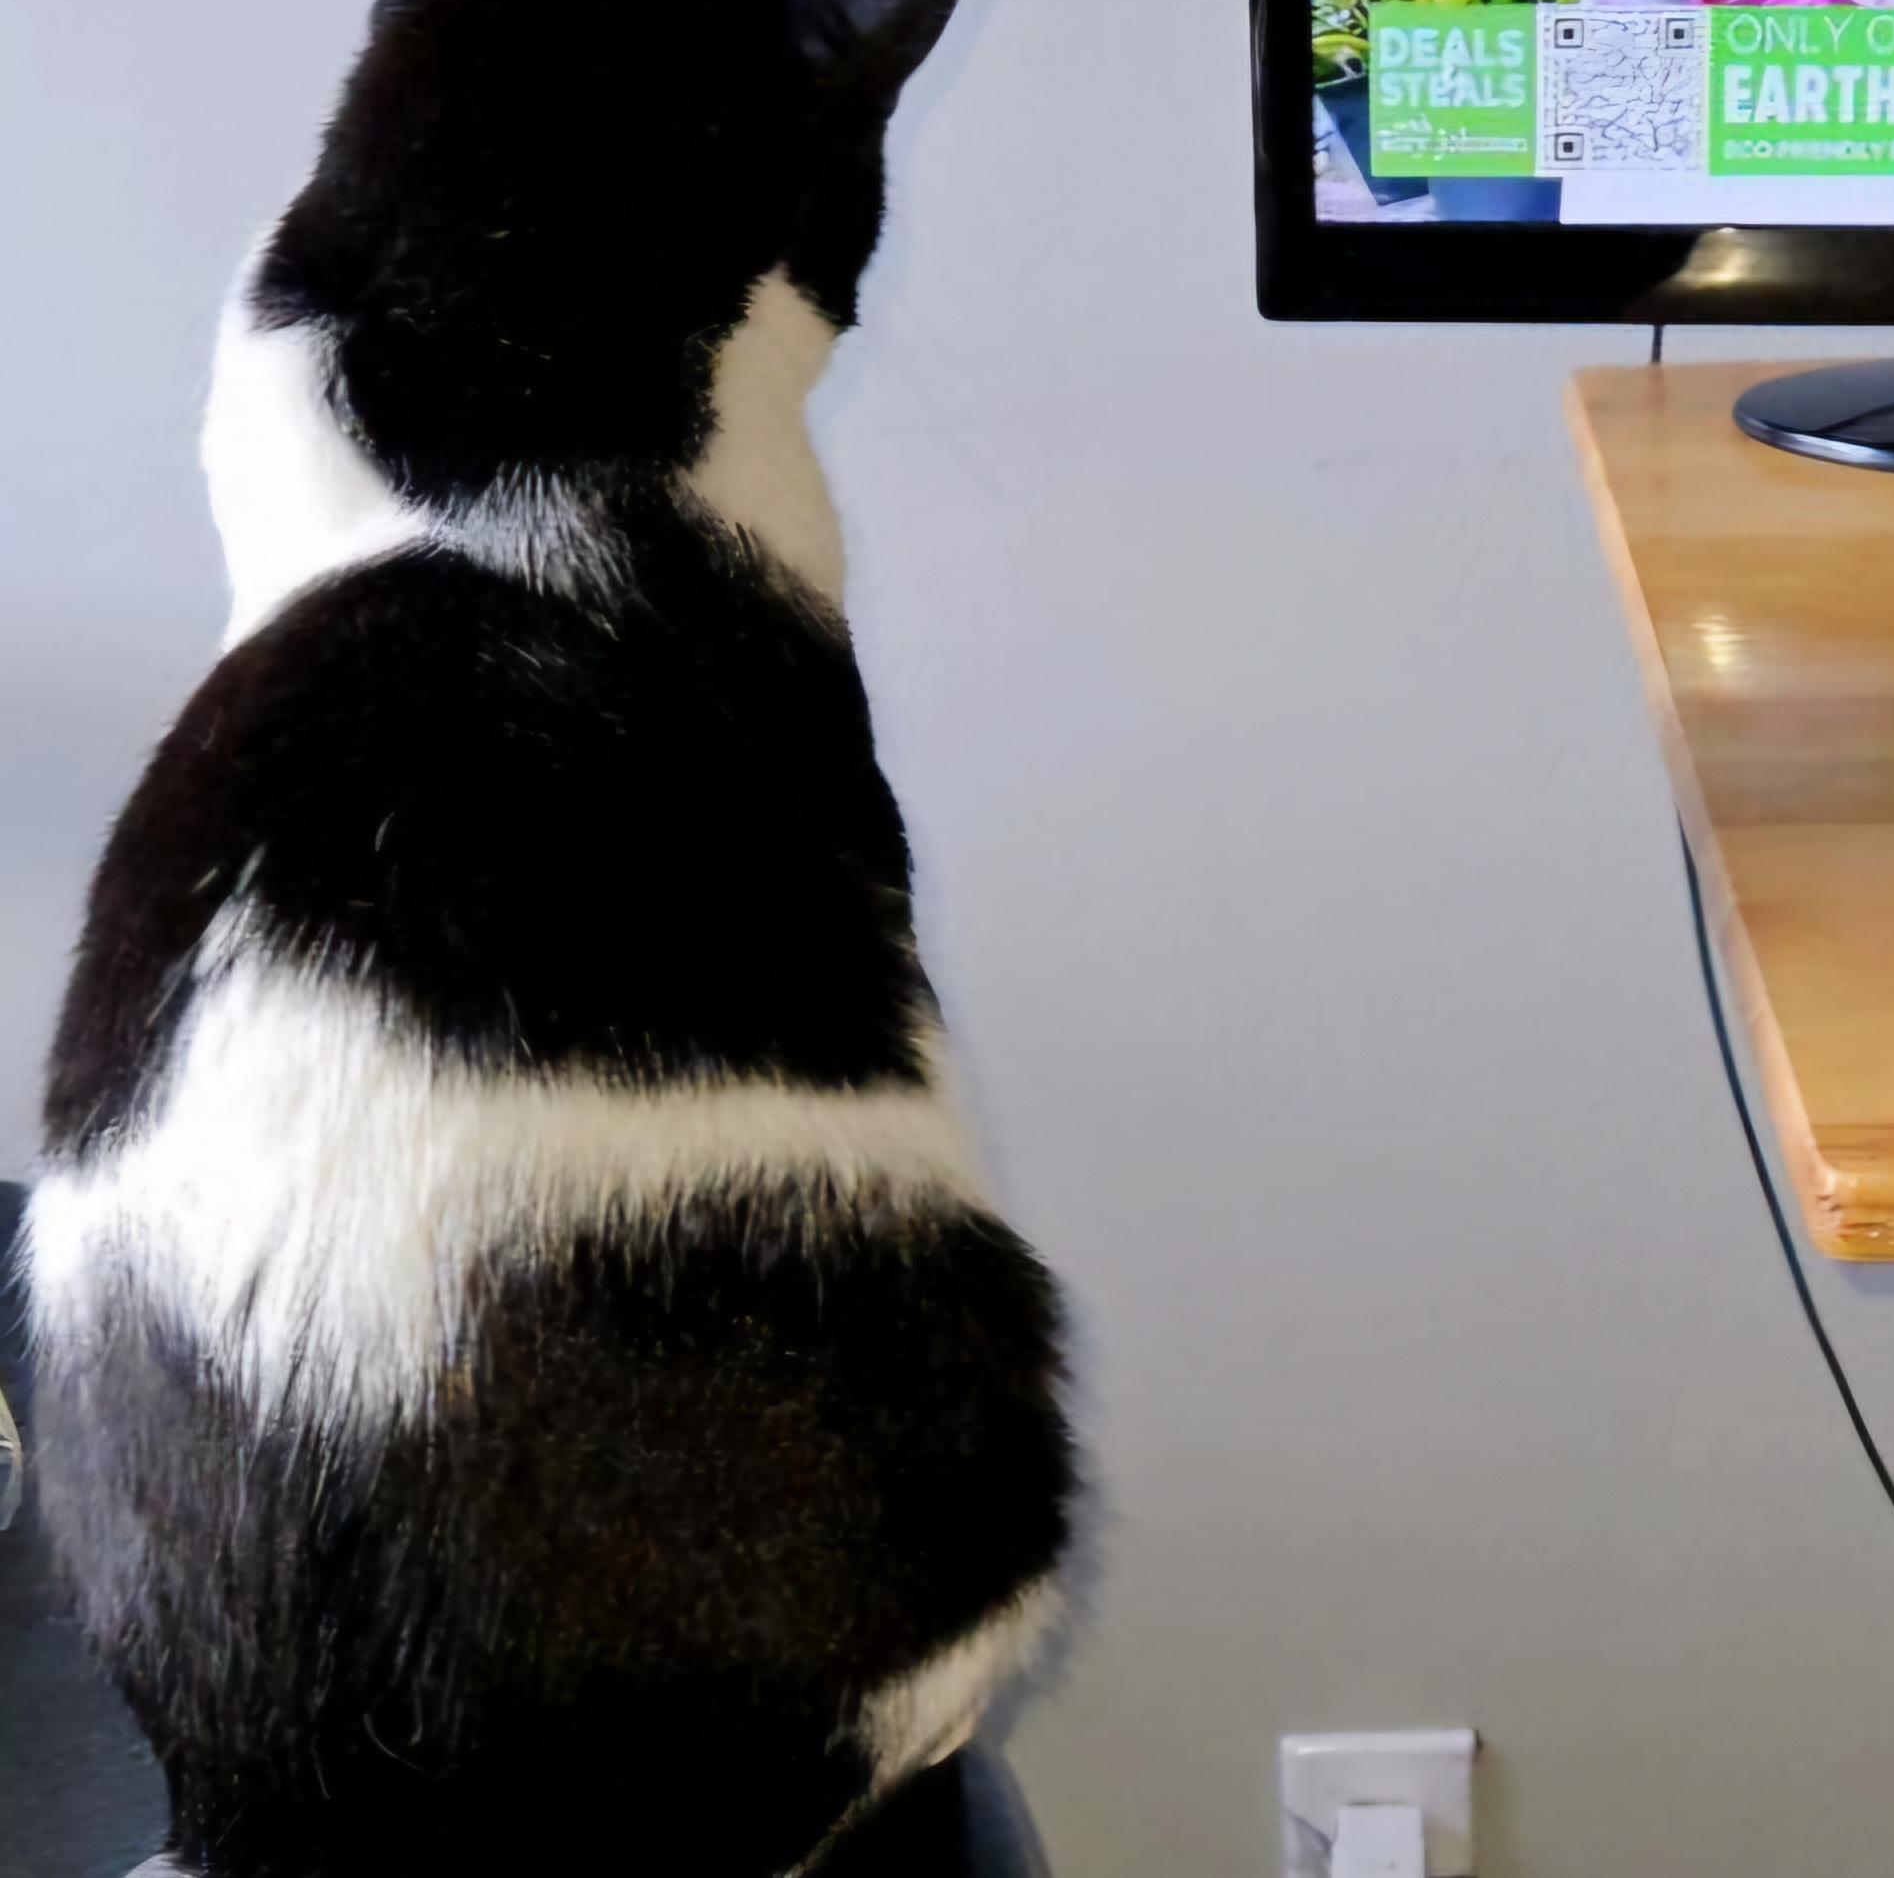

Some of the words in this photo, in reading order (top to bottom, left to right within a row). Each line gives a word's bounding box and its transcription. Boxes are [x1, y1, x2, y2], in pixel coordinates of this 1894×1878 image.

[1378, 26, 1525, 68] DEALS
[1726, 15, 1855, 54] ONLY
[1380, 73, 1526, 108] STEALS
